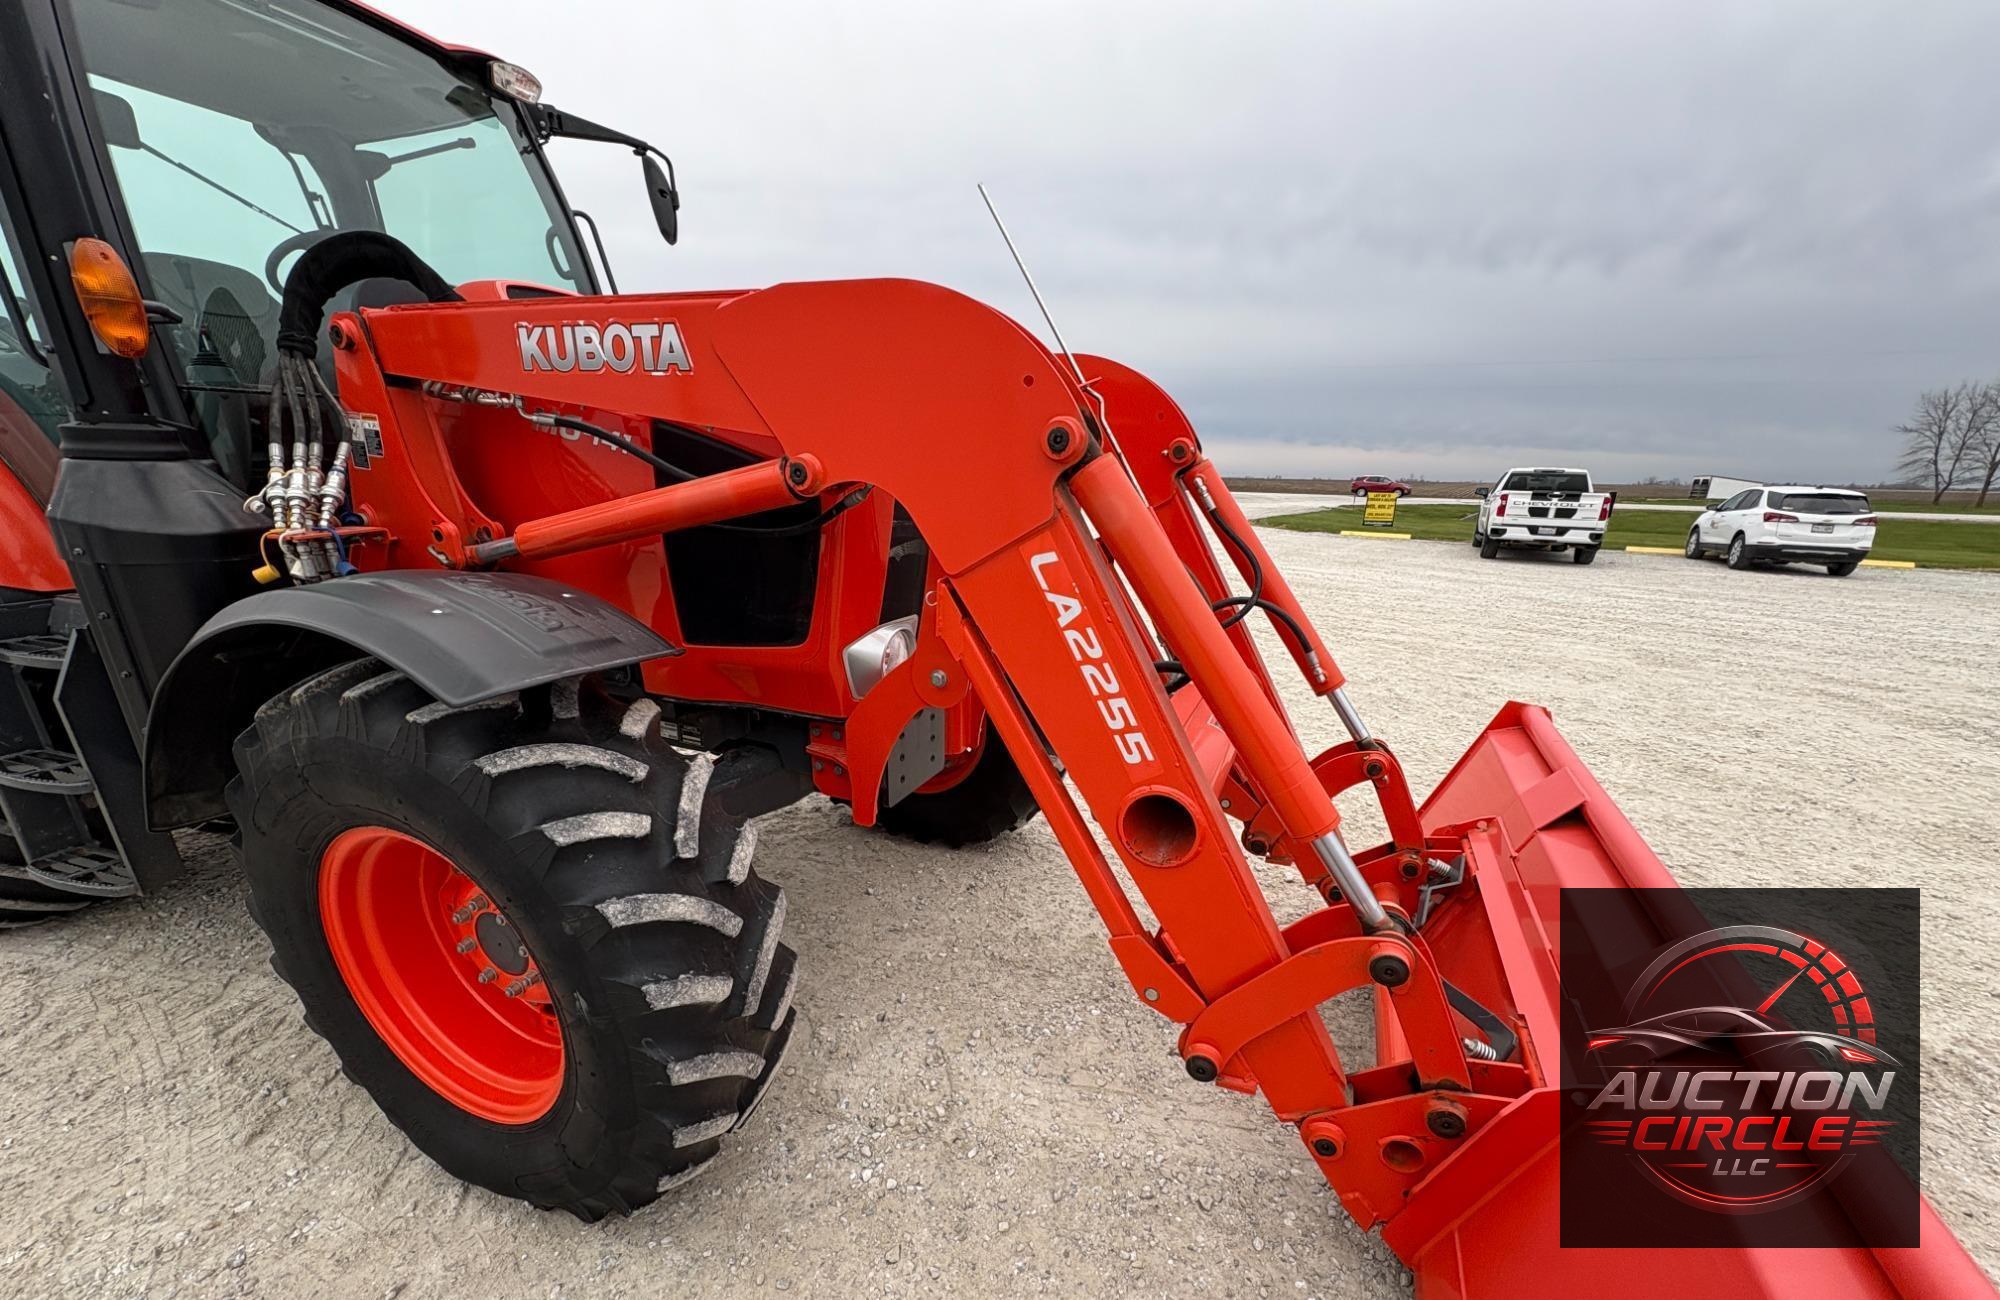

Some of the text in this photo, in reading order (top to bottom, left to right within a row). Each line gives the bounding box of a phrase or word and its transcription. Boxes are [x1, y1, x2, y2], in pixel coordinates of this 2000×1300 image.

[517, 322, 692, 374] KUBOTA
[1512, 500, 1597, 508] CHEVROLET
[1030, 551, 1155, 765] LA2255
